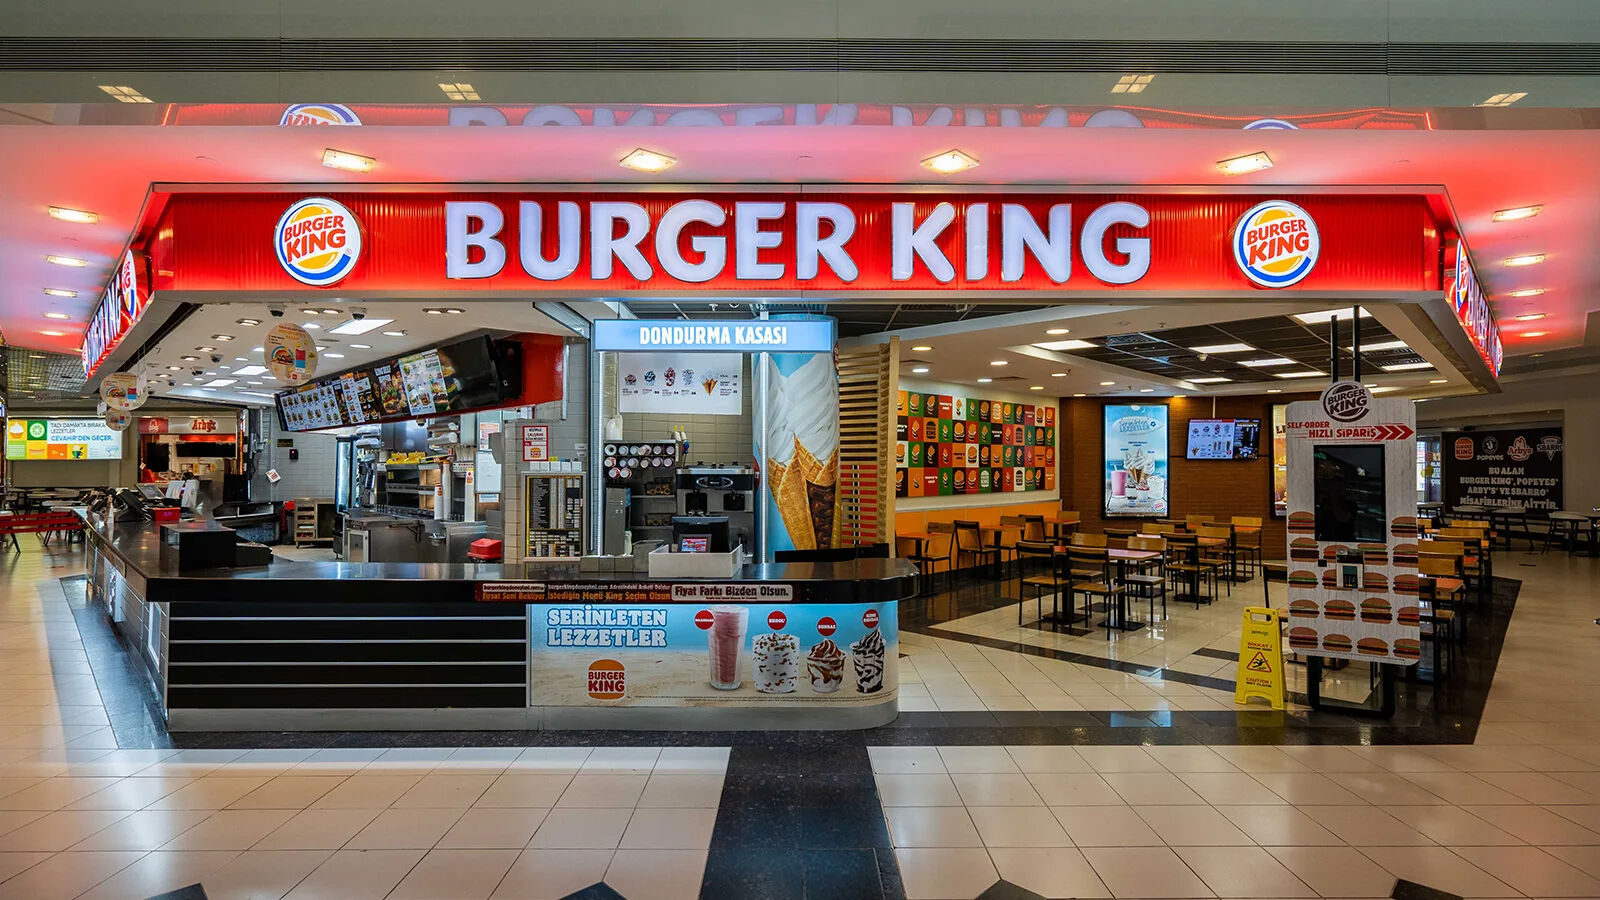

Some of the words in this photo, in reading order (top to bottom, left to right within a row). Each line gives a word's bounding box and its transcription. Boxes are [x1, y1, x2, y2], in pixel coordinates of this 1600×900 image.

[284, 215, 344, 243] BURGER
[1247, 219, 1307, 246] BURGER
[286, 228, 346, 263] KING
[445, 199, 859, 283] BURGER
[891, 201, 1151, 285] KING
[1249, 231, 1309, 266] KING
[640, 326, 731, 345] DONDURMA
[735, 326, 787, 345] KASASI
[1328, 389, 1365, 405] BURGER
[1329, 397, 1368, 414] KING
[1287, 421, 1330, 429] SELF-ORDER
[1308, 430, 1334, 438] HIZLI
[1500, 467, 1525, 475] ALAN
[1459, 476, 1490, 485] BURGER
[606, 592, 624, 600] King
[649, 592, 671, 600] Olsun
[675, 586, 697, 597] Fiyat
[699, 586, 723, 597] Farkı
[725, 586, 757, 597] Bizden
[760, 586, 789, 597] Olsun.
[547, 604, 667, 626] SERİNLETEN
[547, 628, 668, 647] LEZZETLER
[588, 671, 625, 680] BURGER
[588, 680, 625, 692] KING
